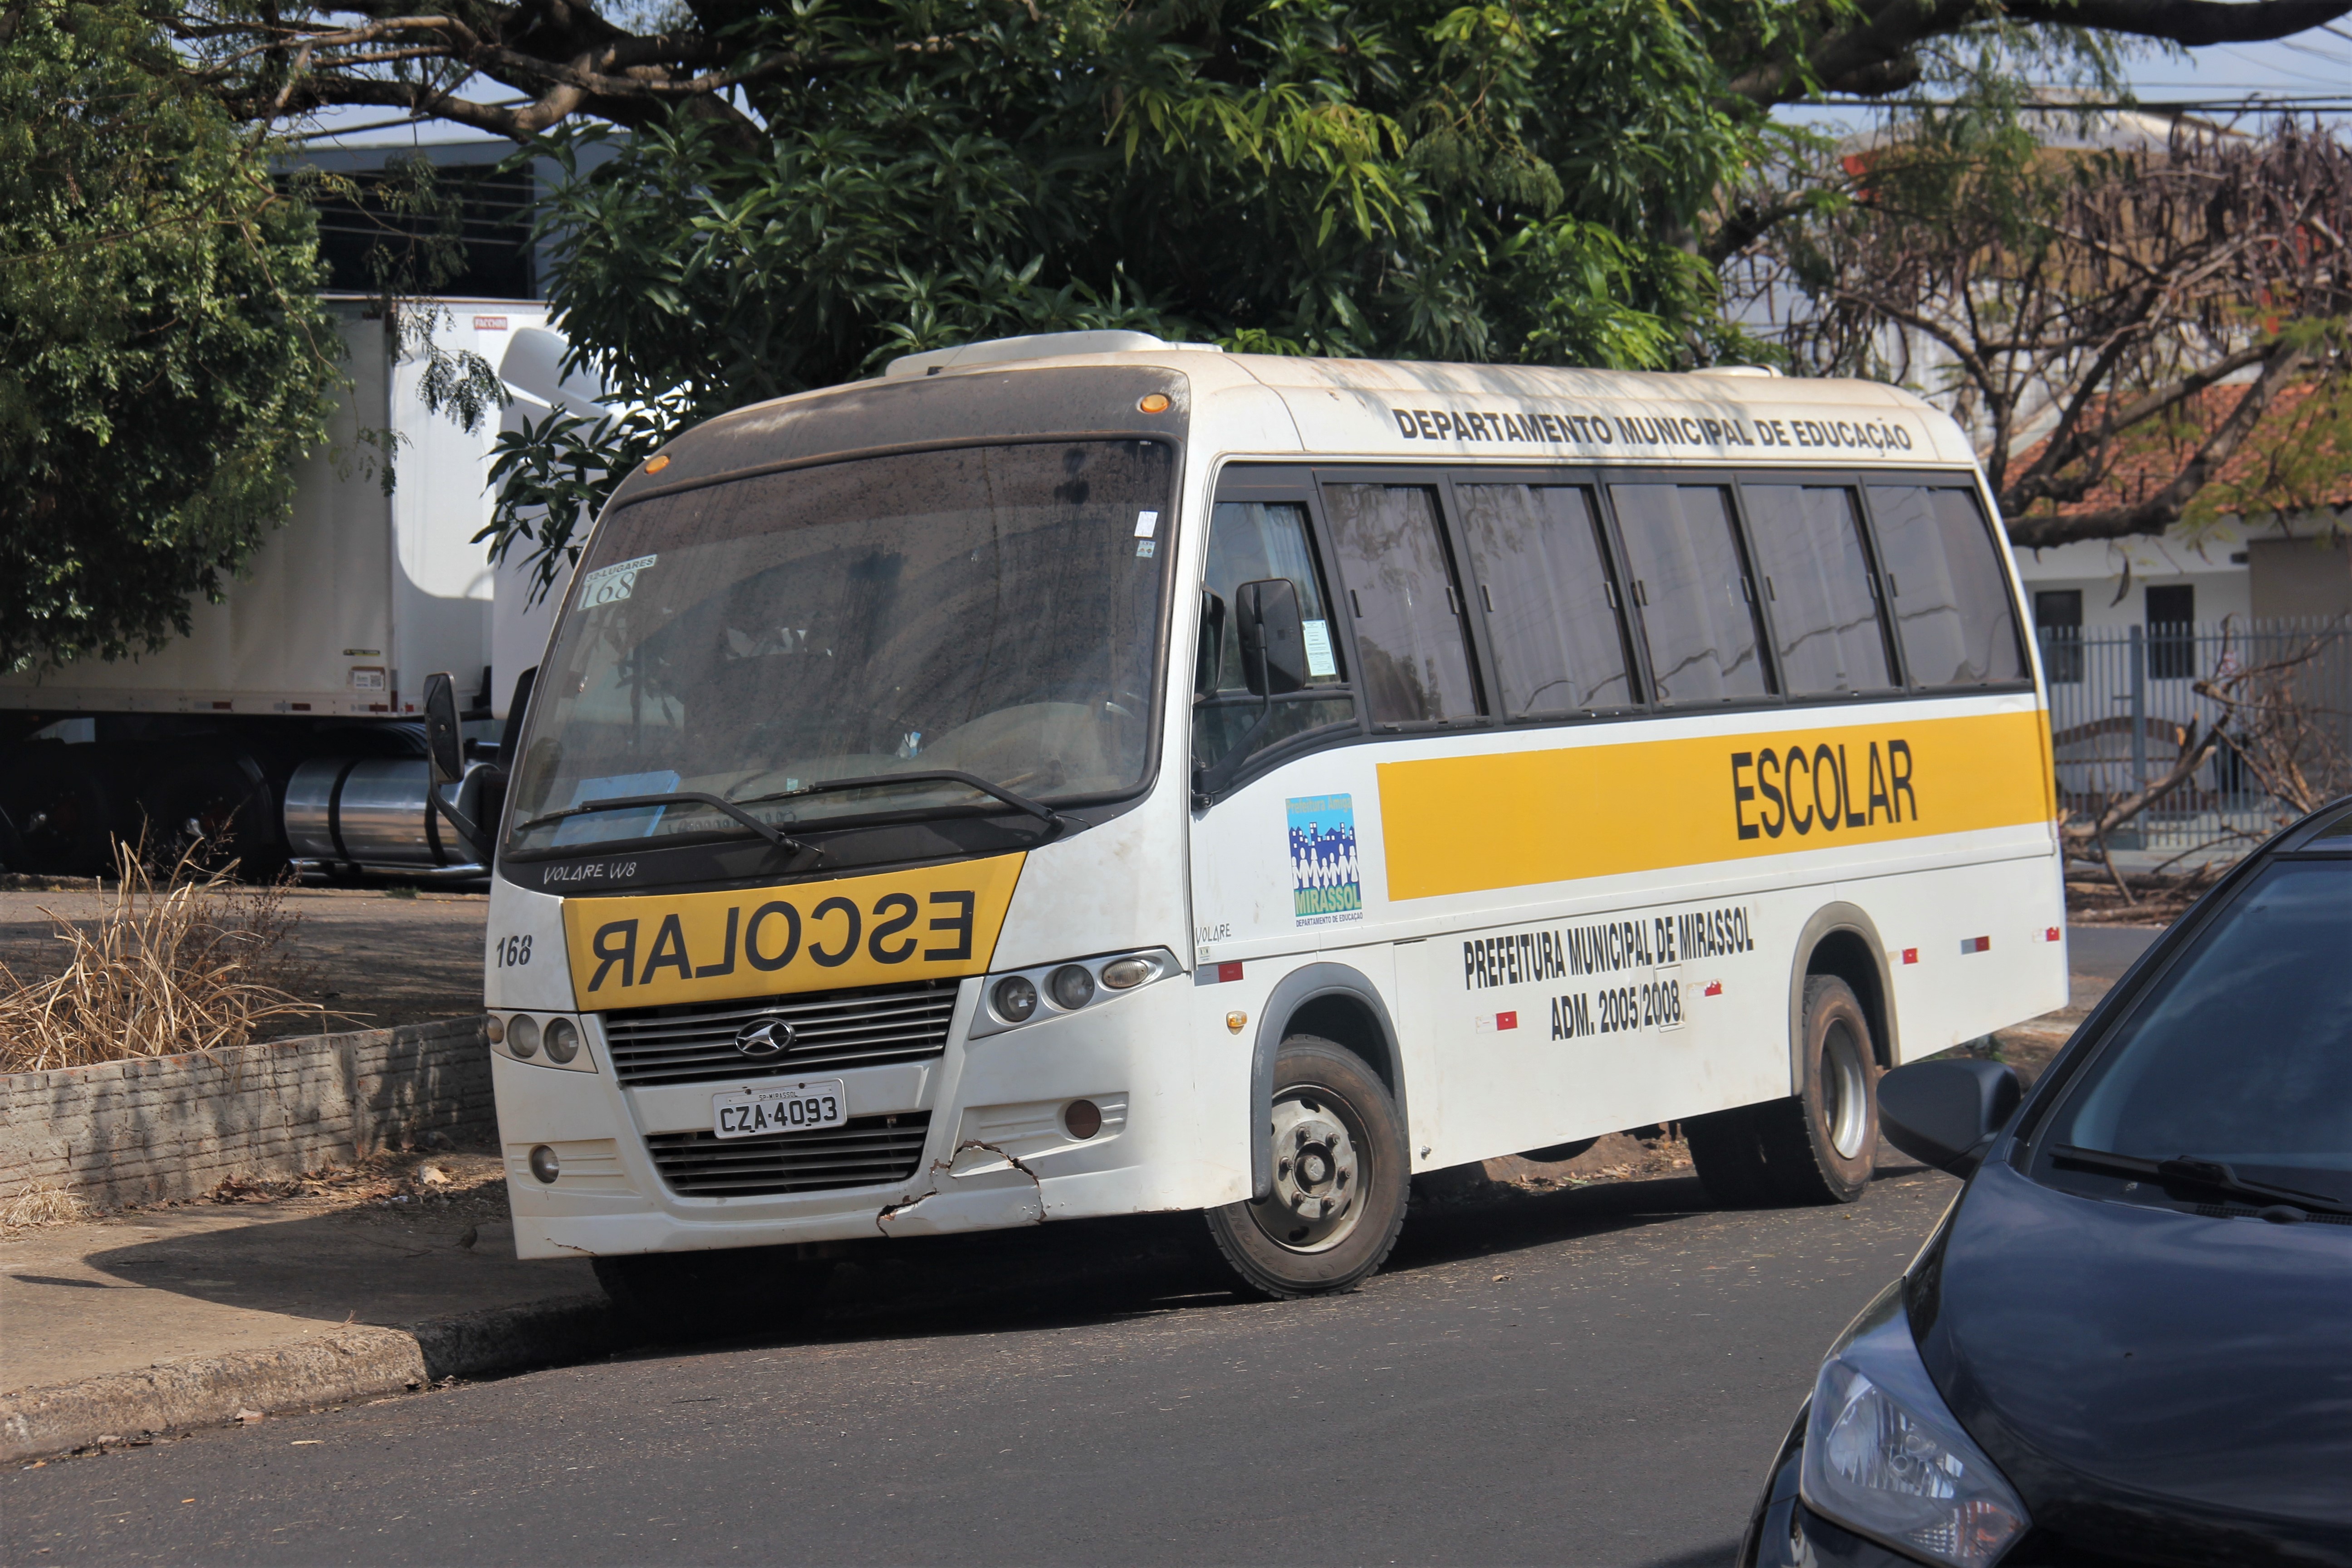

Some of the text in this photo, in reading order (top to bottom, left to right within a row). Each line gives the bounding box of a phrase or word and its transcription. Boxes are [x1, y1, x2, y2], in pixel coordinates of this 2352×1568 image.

[1391, 408, 1614, 446] DEPARTAMENTO
[1616, 415, 1754, 447] MUNICIPAL
[1753, 419, 1791, 446] DE
[581, 572, 636, 608] 168
[1285, 795, 1353, 814] Prefeitura Amiga
[1730, 739, 1918, 840] ESCOLAR
[544, 862, 637, 885] VOLARE W8
[1294, 884, 1361, 915] MIRASSOL
[1195, 923, 1232, 946] VOLARE
[1296, 916, 1332, 927] DEPARTAMENTO
[1332, 915, 1338, 923] DE
[496, 935, 533, 968] 168
[1463, 906, 1754, 990] PREFEITURA MUNICIPAL DE MIRASSOL
[1551, 979, 1681, 1041] ADM. 2005/2008
[759, 1091, 798, 1101] SP-MIRASSOL
